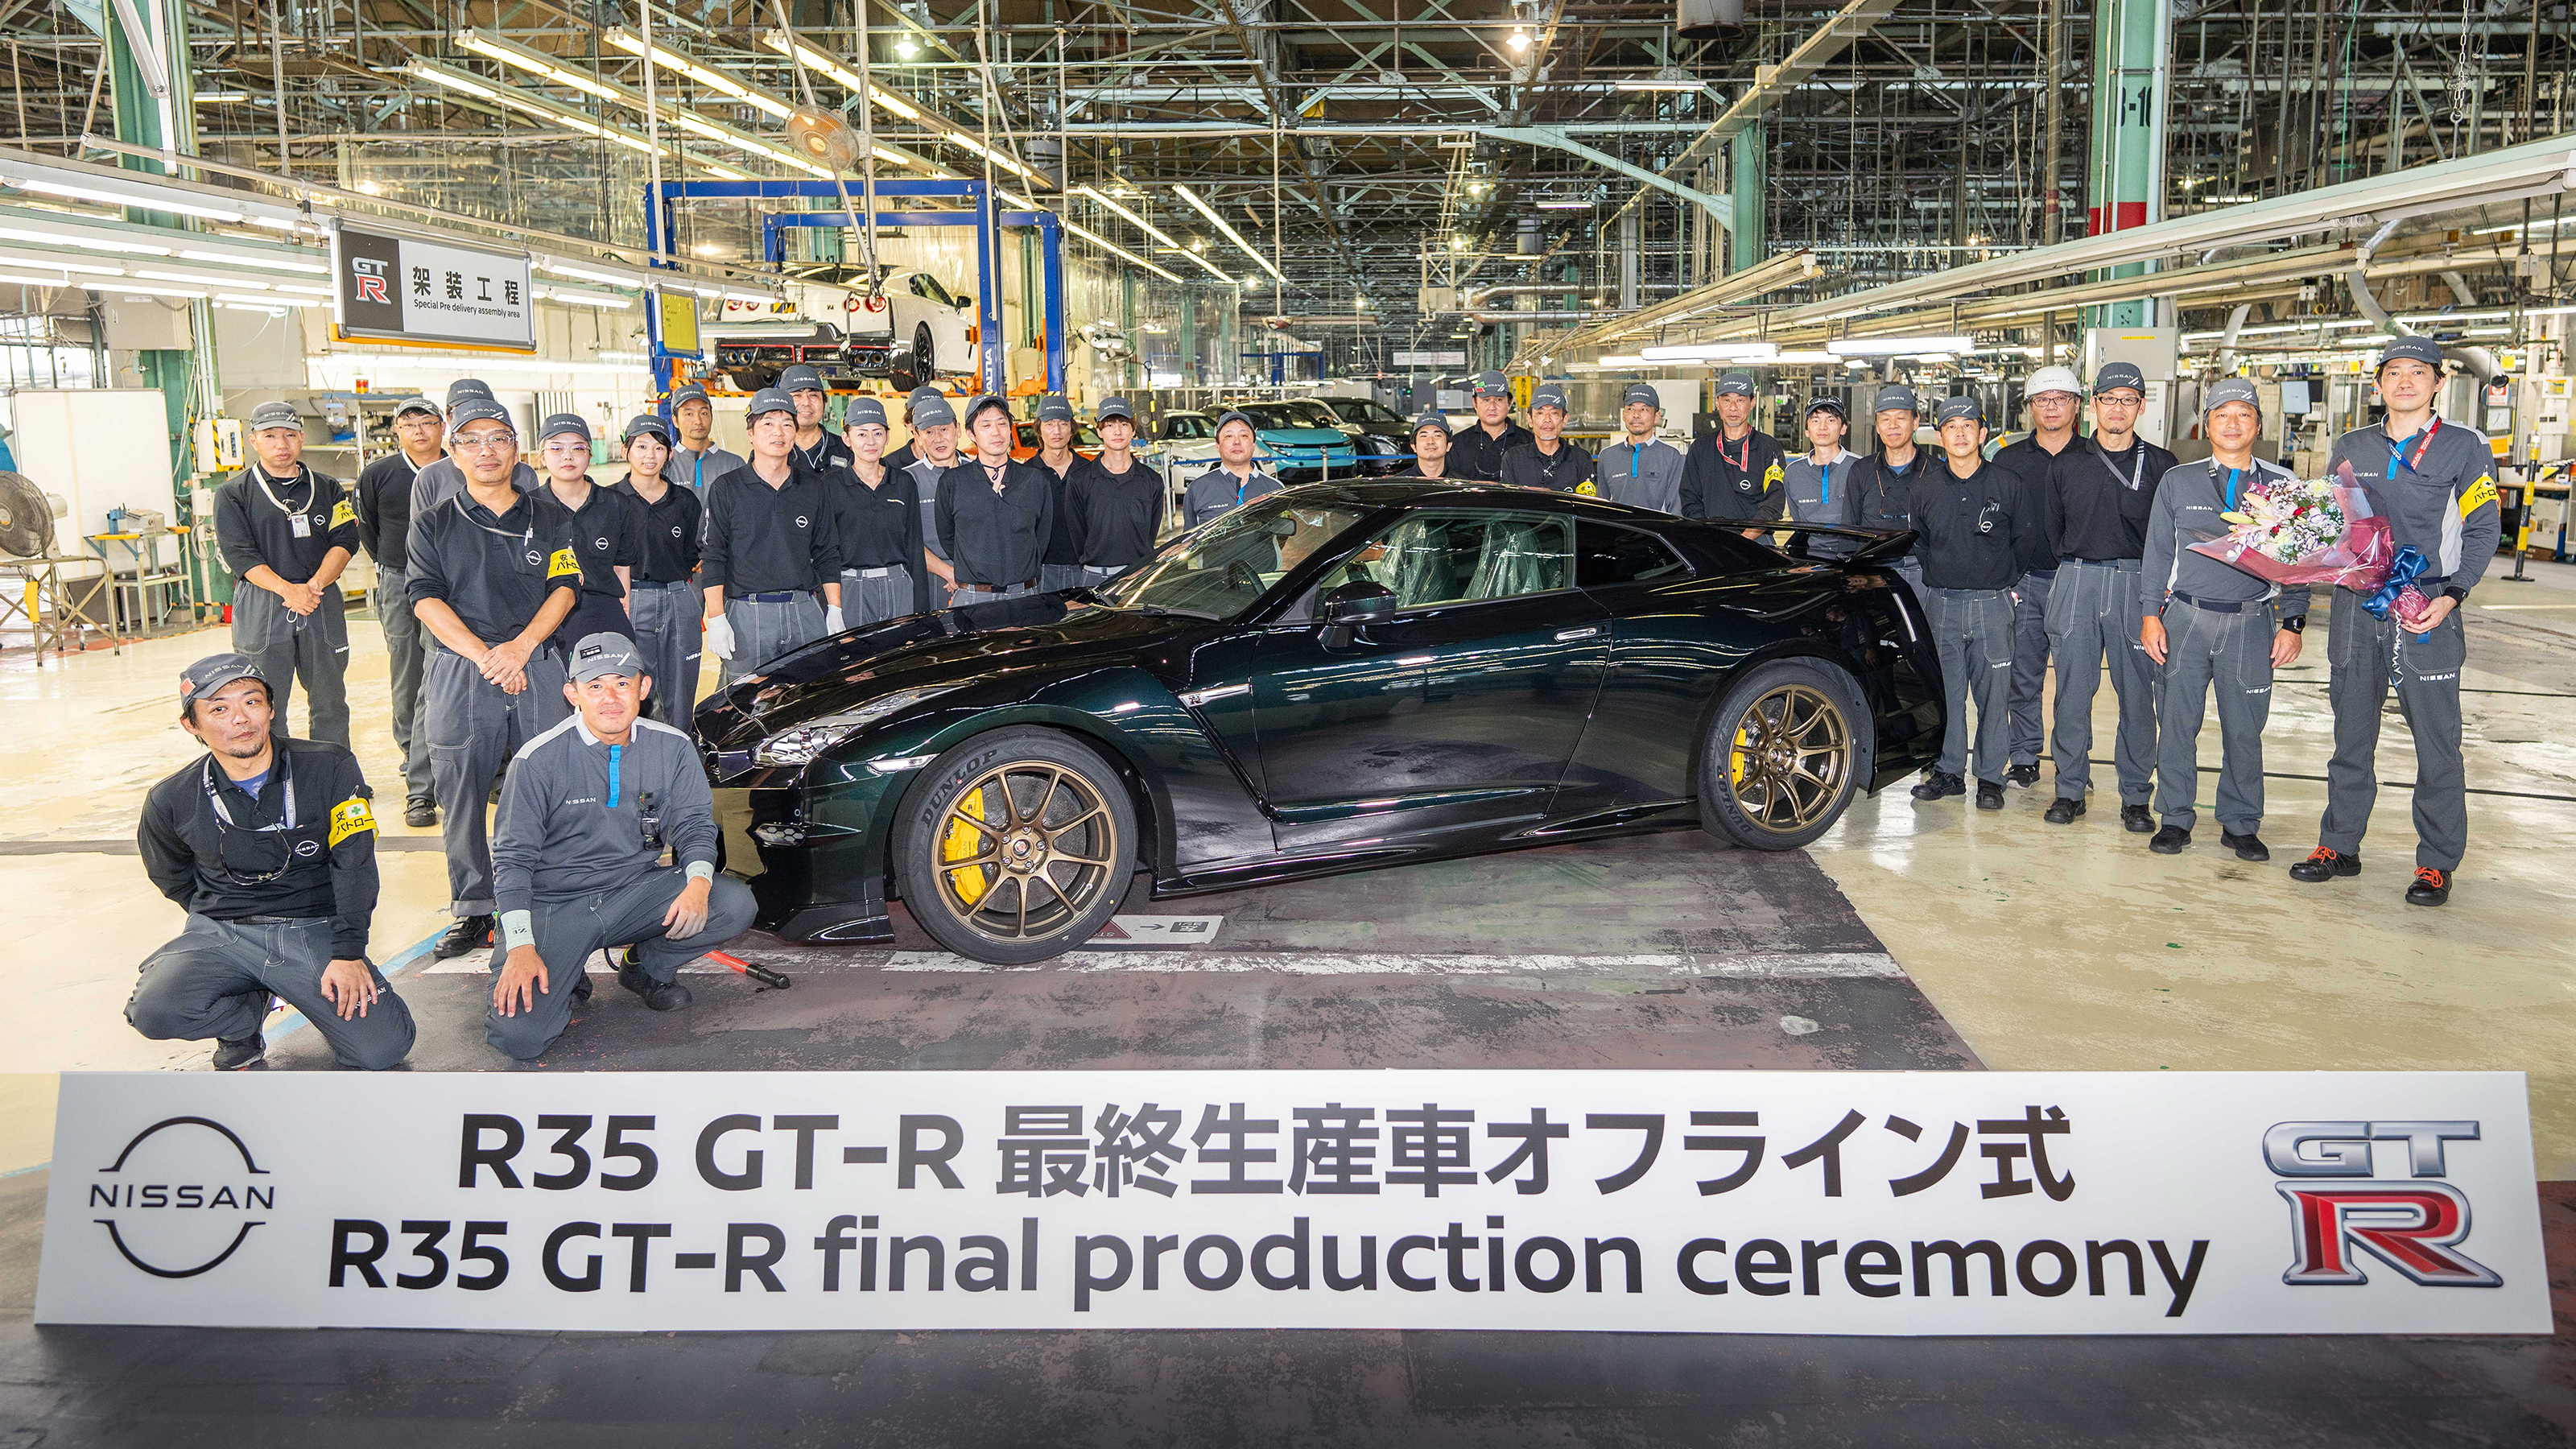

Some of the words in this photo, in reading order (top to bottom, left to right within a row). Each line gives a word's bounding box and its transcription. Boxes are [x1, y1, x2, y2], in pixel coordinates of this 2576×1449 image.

[352, 256, 389, 276] GT
[354, 273, 392, 305] R
[412, 266, 520, 306] 架装工程
[414, 299, 439, 310] Special
[440, 302, 451, 311] Pre
[452, 303, 477, 315] delivery
[478, 307, 506, 318] assembly
[985, 347, 993, 392] ALTIA
[464, 407, 497, 417] NISSAN
[921, 409, 943, 418] NISSAN
[1943, 404, 1967, 413] NISSAN
[640, 422, 665, 430] NISSAN
[587, 653, 623, 663] NISSAN
[204, 664, 244, 679] NISSAN
[2419, 672, 2455, 682] NISSAN
[2246, 685, 2272, 695] NISSAN
[920, 749, 998, 828] DUNLOP
[565, 797, 597, 805] NISSAN
[217, 805, 229, 822] NISSAN
[335, 810, 345, 824] 安
[295, 842, 320, 853] NISSAN
[459, 1114, 658, 1191] R35
[696, 1115, 964, 1191] GT-R
[996, 1102, 2076, 1202] 最終生産車オフライン式
[2262, 1120, 2480, 1179] GT
[89, 1184, 275, 1210] NISSAN
[2274, 1179, 2505, 1288] R
[329, 1220, 510, 1291] R35
[543, 1222, 786, 1293] GT-R
[814, 1215, 1038, 1292] final
[1075, 1216, 1643, 1312] production
[1678, 1238, 2210, 1318] ceremony
